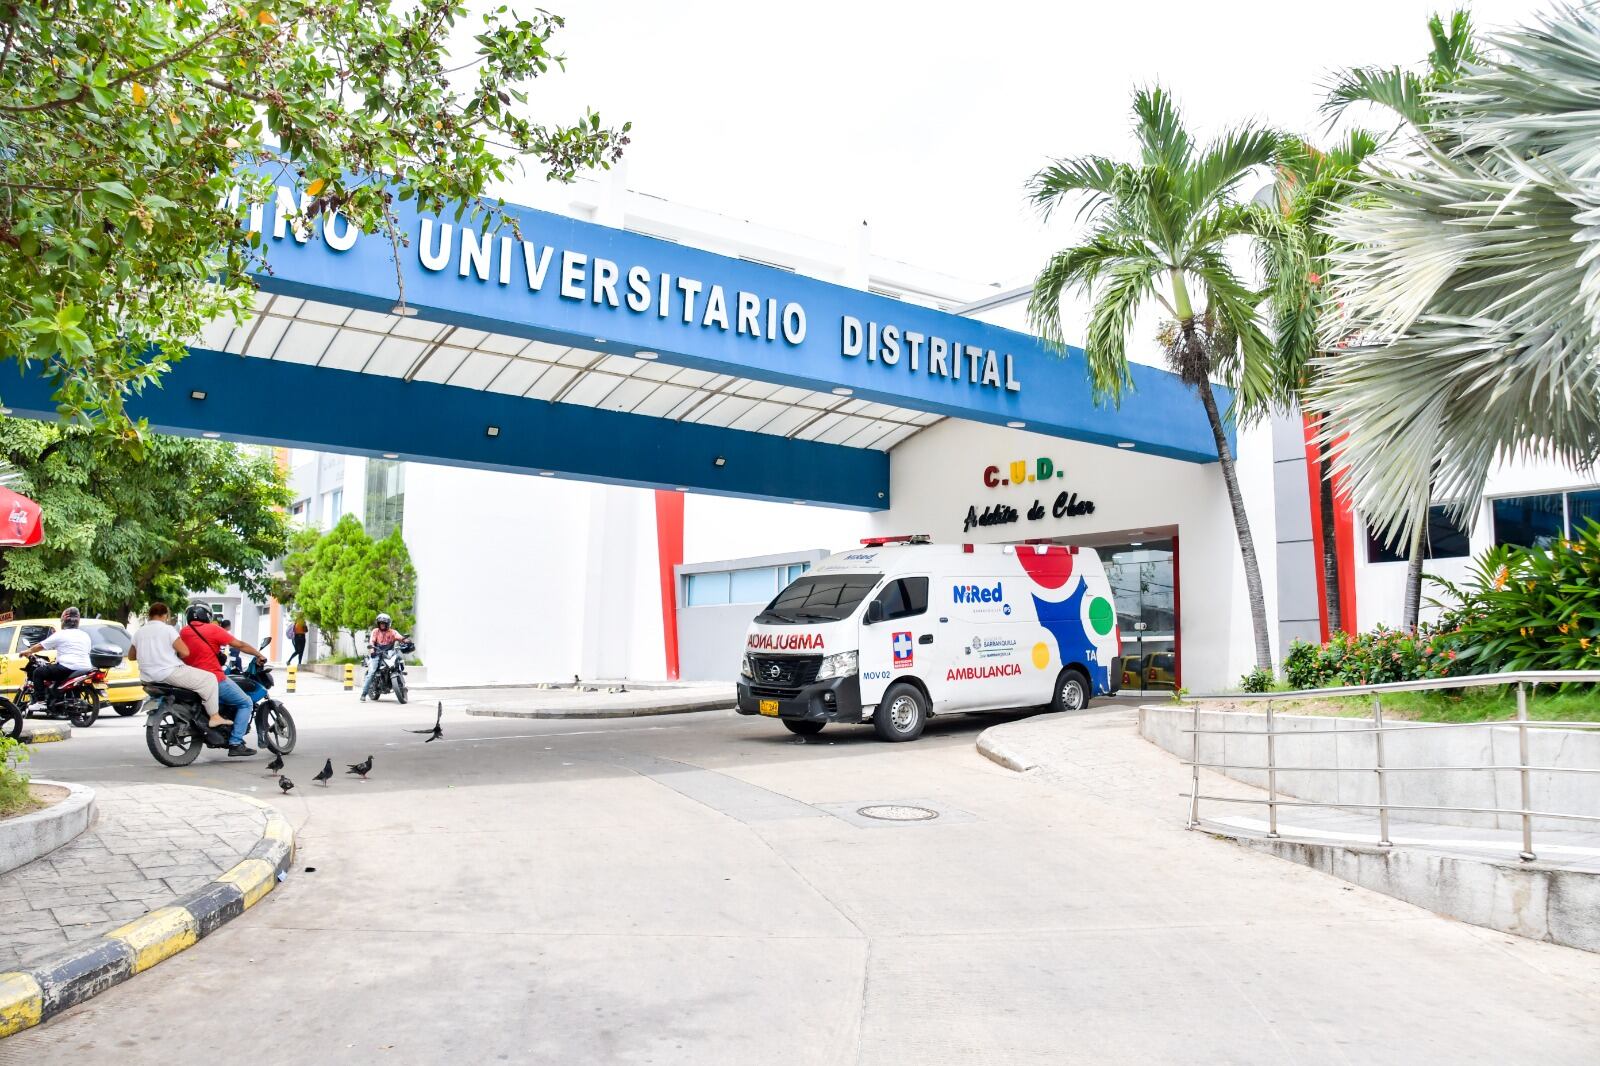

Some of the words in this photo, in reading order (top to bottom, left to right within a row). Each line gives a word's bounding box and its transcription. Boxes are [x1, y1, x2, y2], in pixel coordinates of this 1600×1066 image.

[418, 217, 807, 346] UNIVERSITARIO
[841, 315, 1021, 392] DISTRITAL
[983, 457, 1064, 488] C.U.D.
[1026, 499, 1046, 521] de
[863, 671, 881, 680] MOV
[881, 670, 891, 679] 02
[946, 663, 1022, 681] AMBULANCIA
